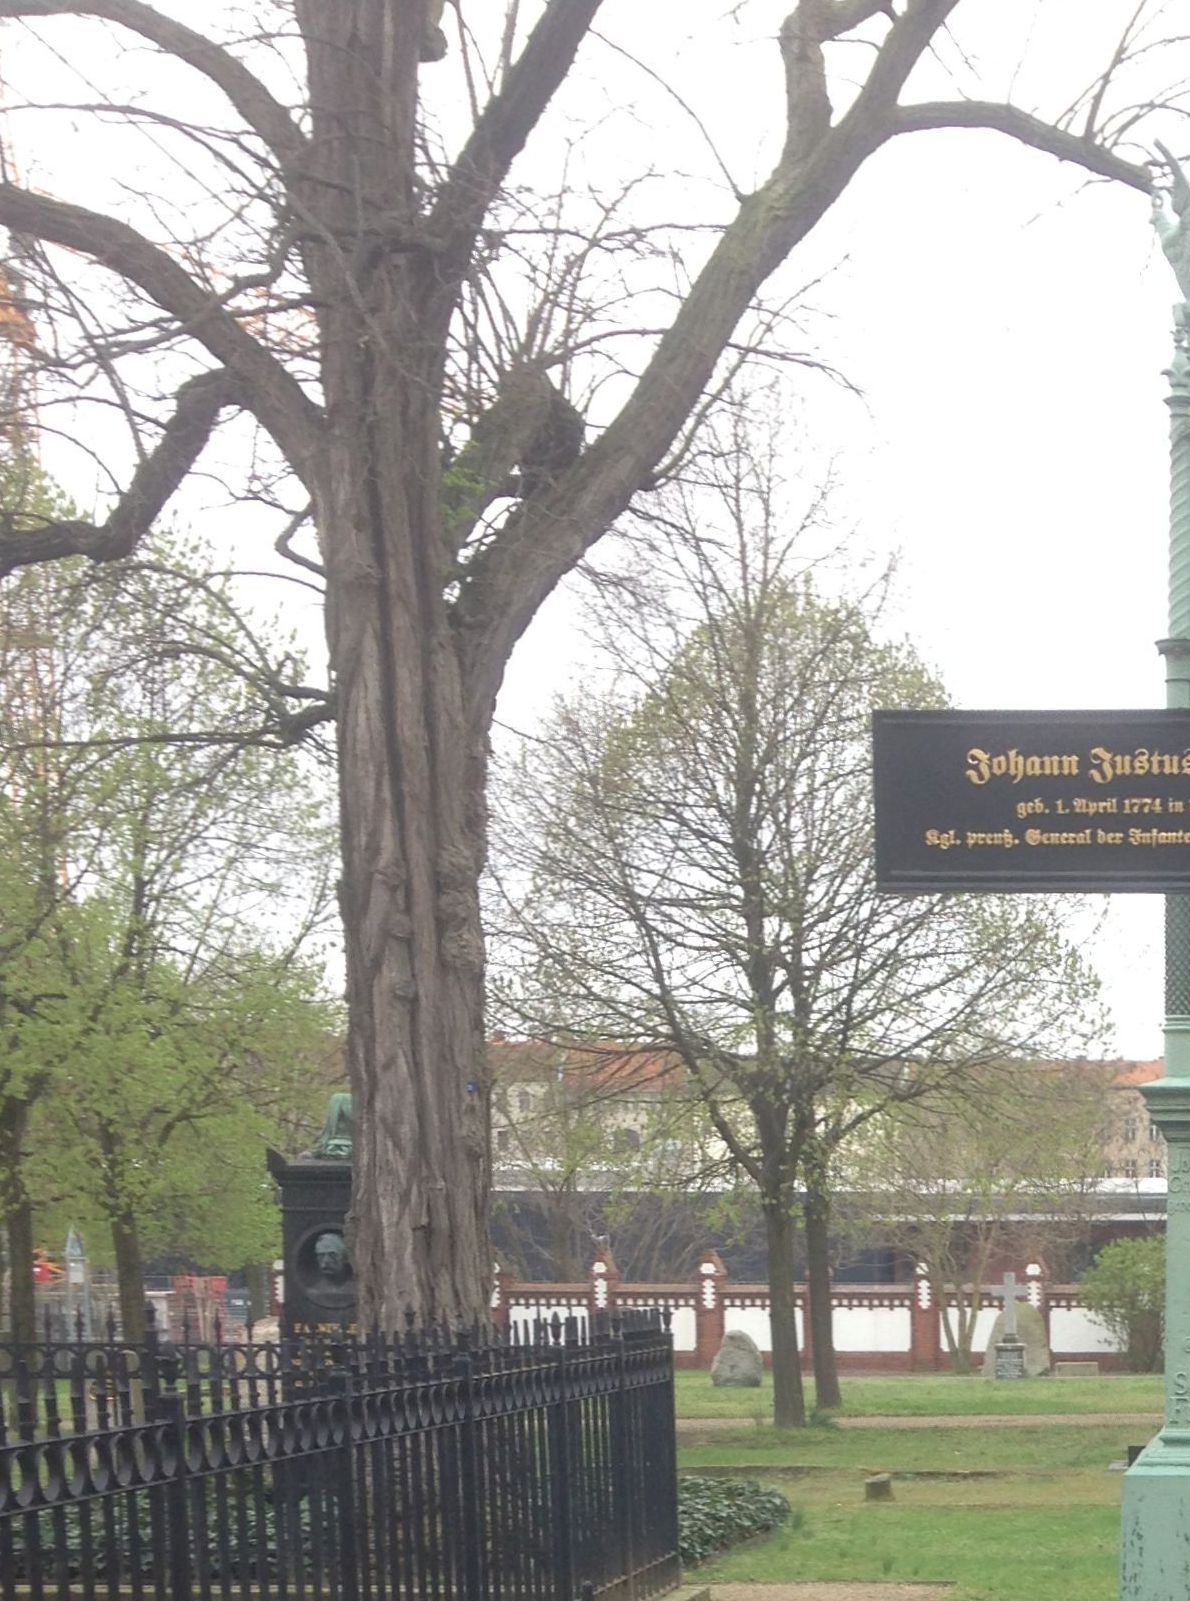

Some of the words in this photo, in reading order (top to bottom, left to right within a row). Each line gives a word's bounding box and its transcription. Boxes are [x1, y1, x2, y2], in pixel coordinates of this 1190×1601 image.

[965, 747, 1080, 786] Johann
[1016, 798, 1049, 818] geb.
[1056, 800, 1070, 814] 1.
[1072, 798, 1118, 816] April
[1122, 797, 1163, 813] 1774
[1167, 799, 1185, 813] in
[925, 829, 962, 850] Kgl.
[1024, 827, 1092, 846] General
[1096, 827, 1124, 845] der
